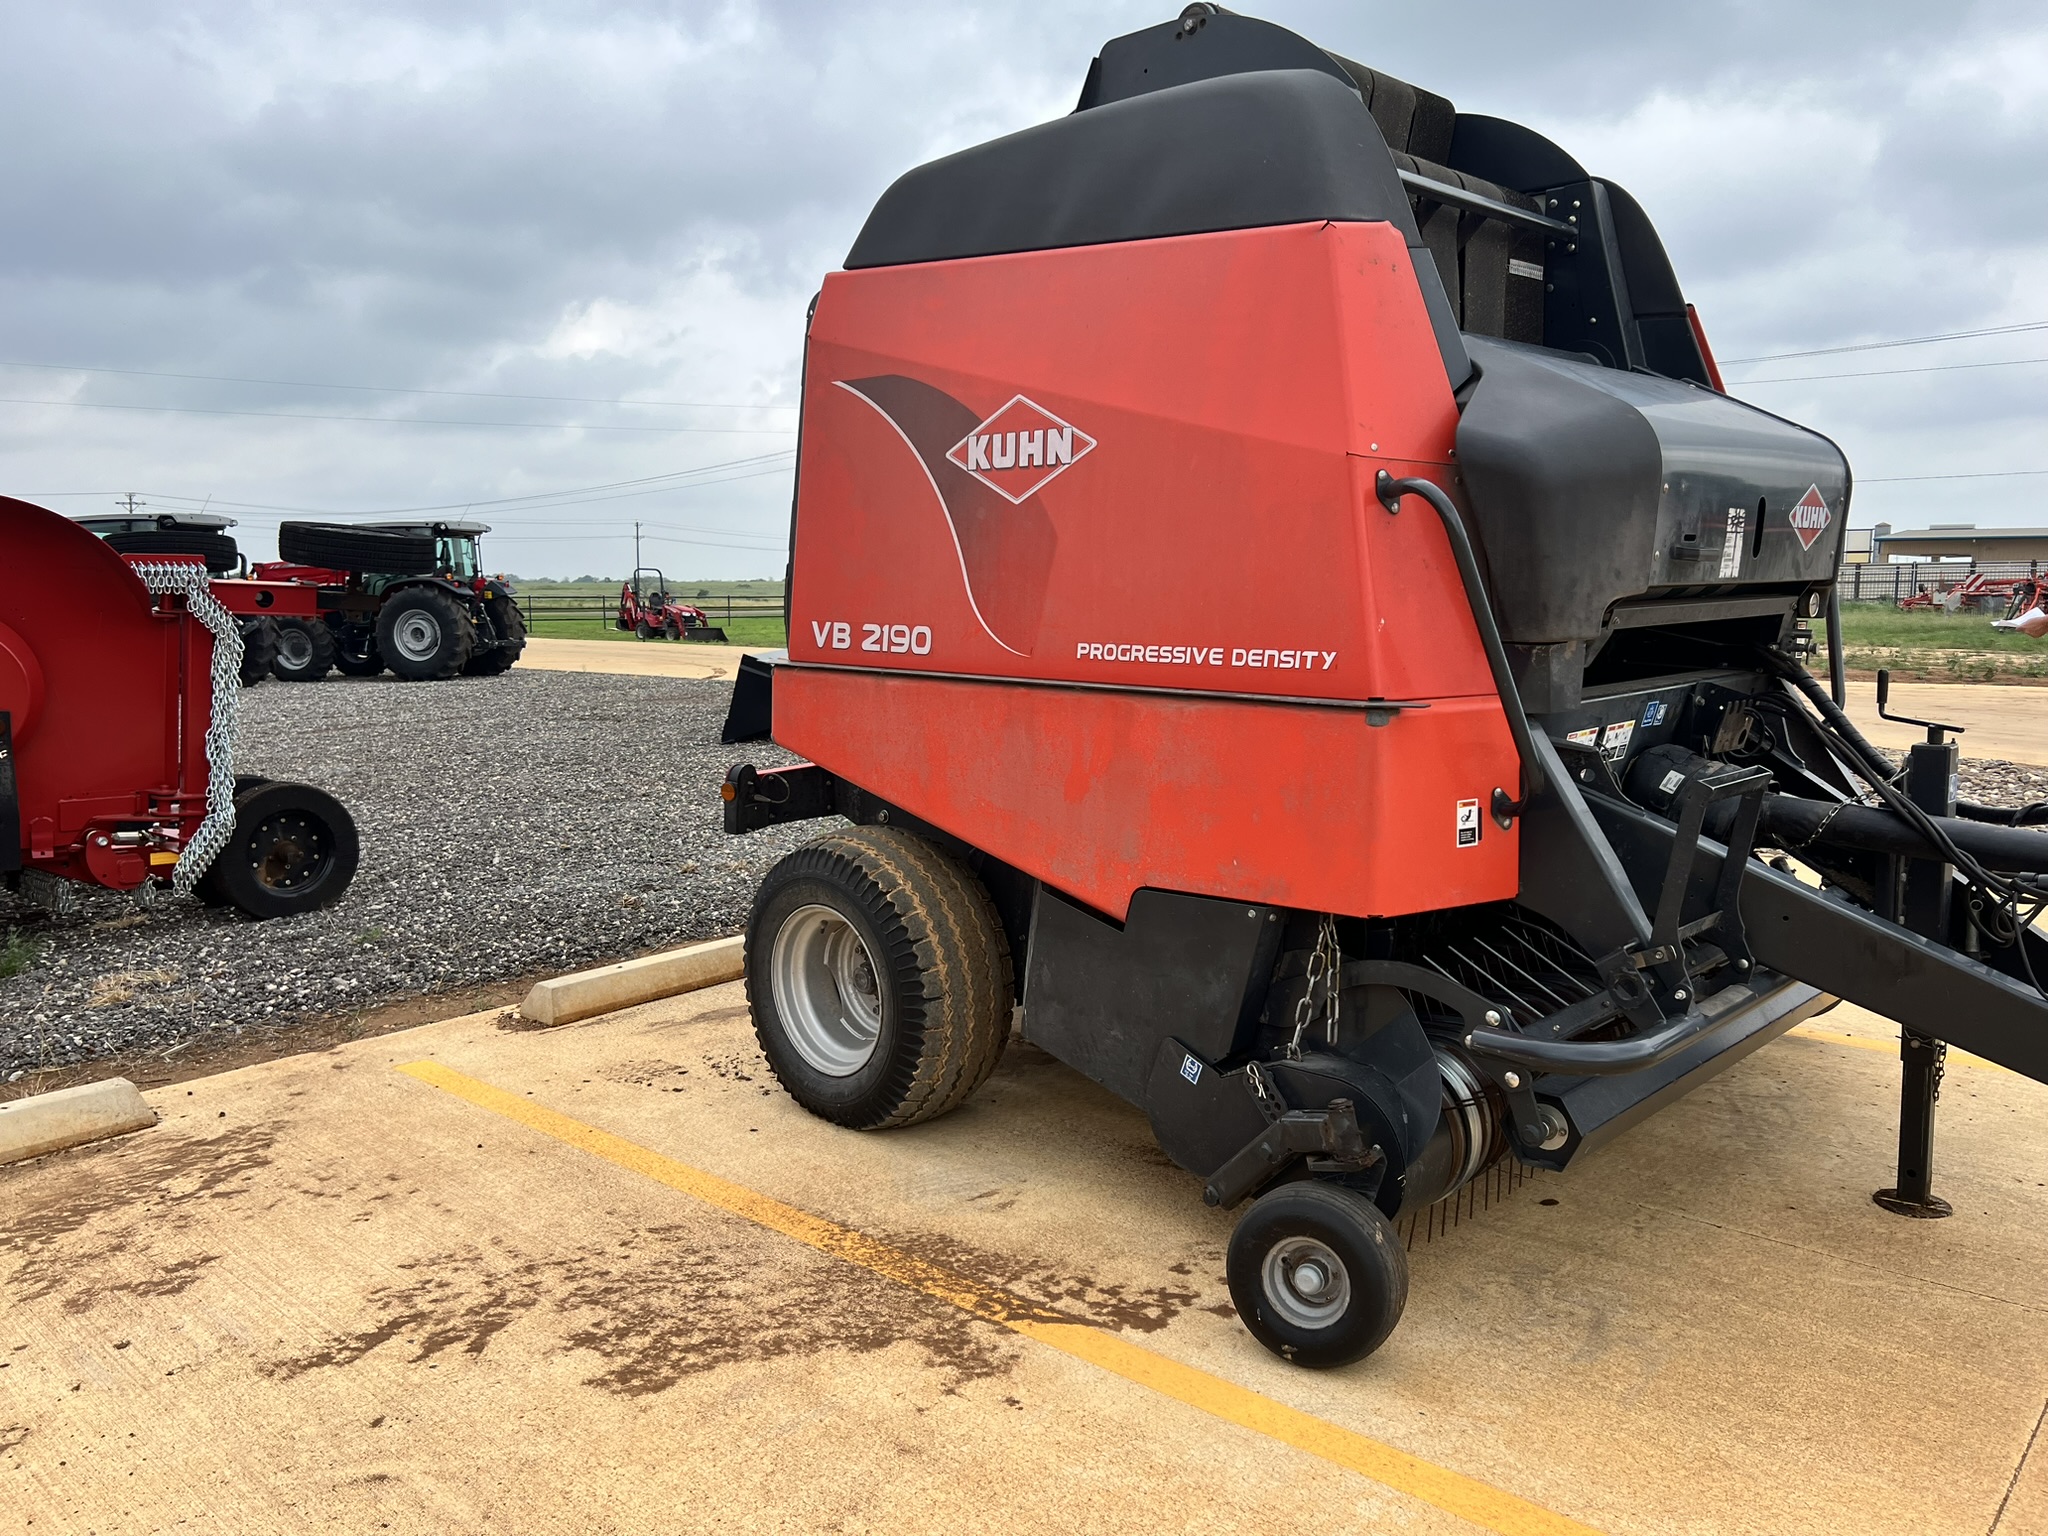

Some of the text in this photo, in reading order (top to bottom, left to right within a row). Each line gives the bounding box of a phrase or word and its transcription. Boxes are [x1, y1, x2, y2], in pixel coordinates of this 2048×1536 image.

[967, 427, 1074, 471] KUHN
[1794, 506, 1827, 529] KUHN
[811, 621, 933, 656] VB 2190
[1076, 643, 1337, 670] PROGRESSIVE DENSITY
